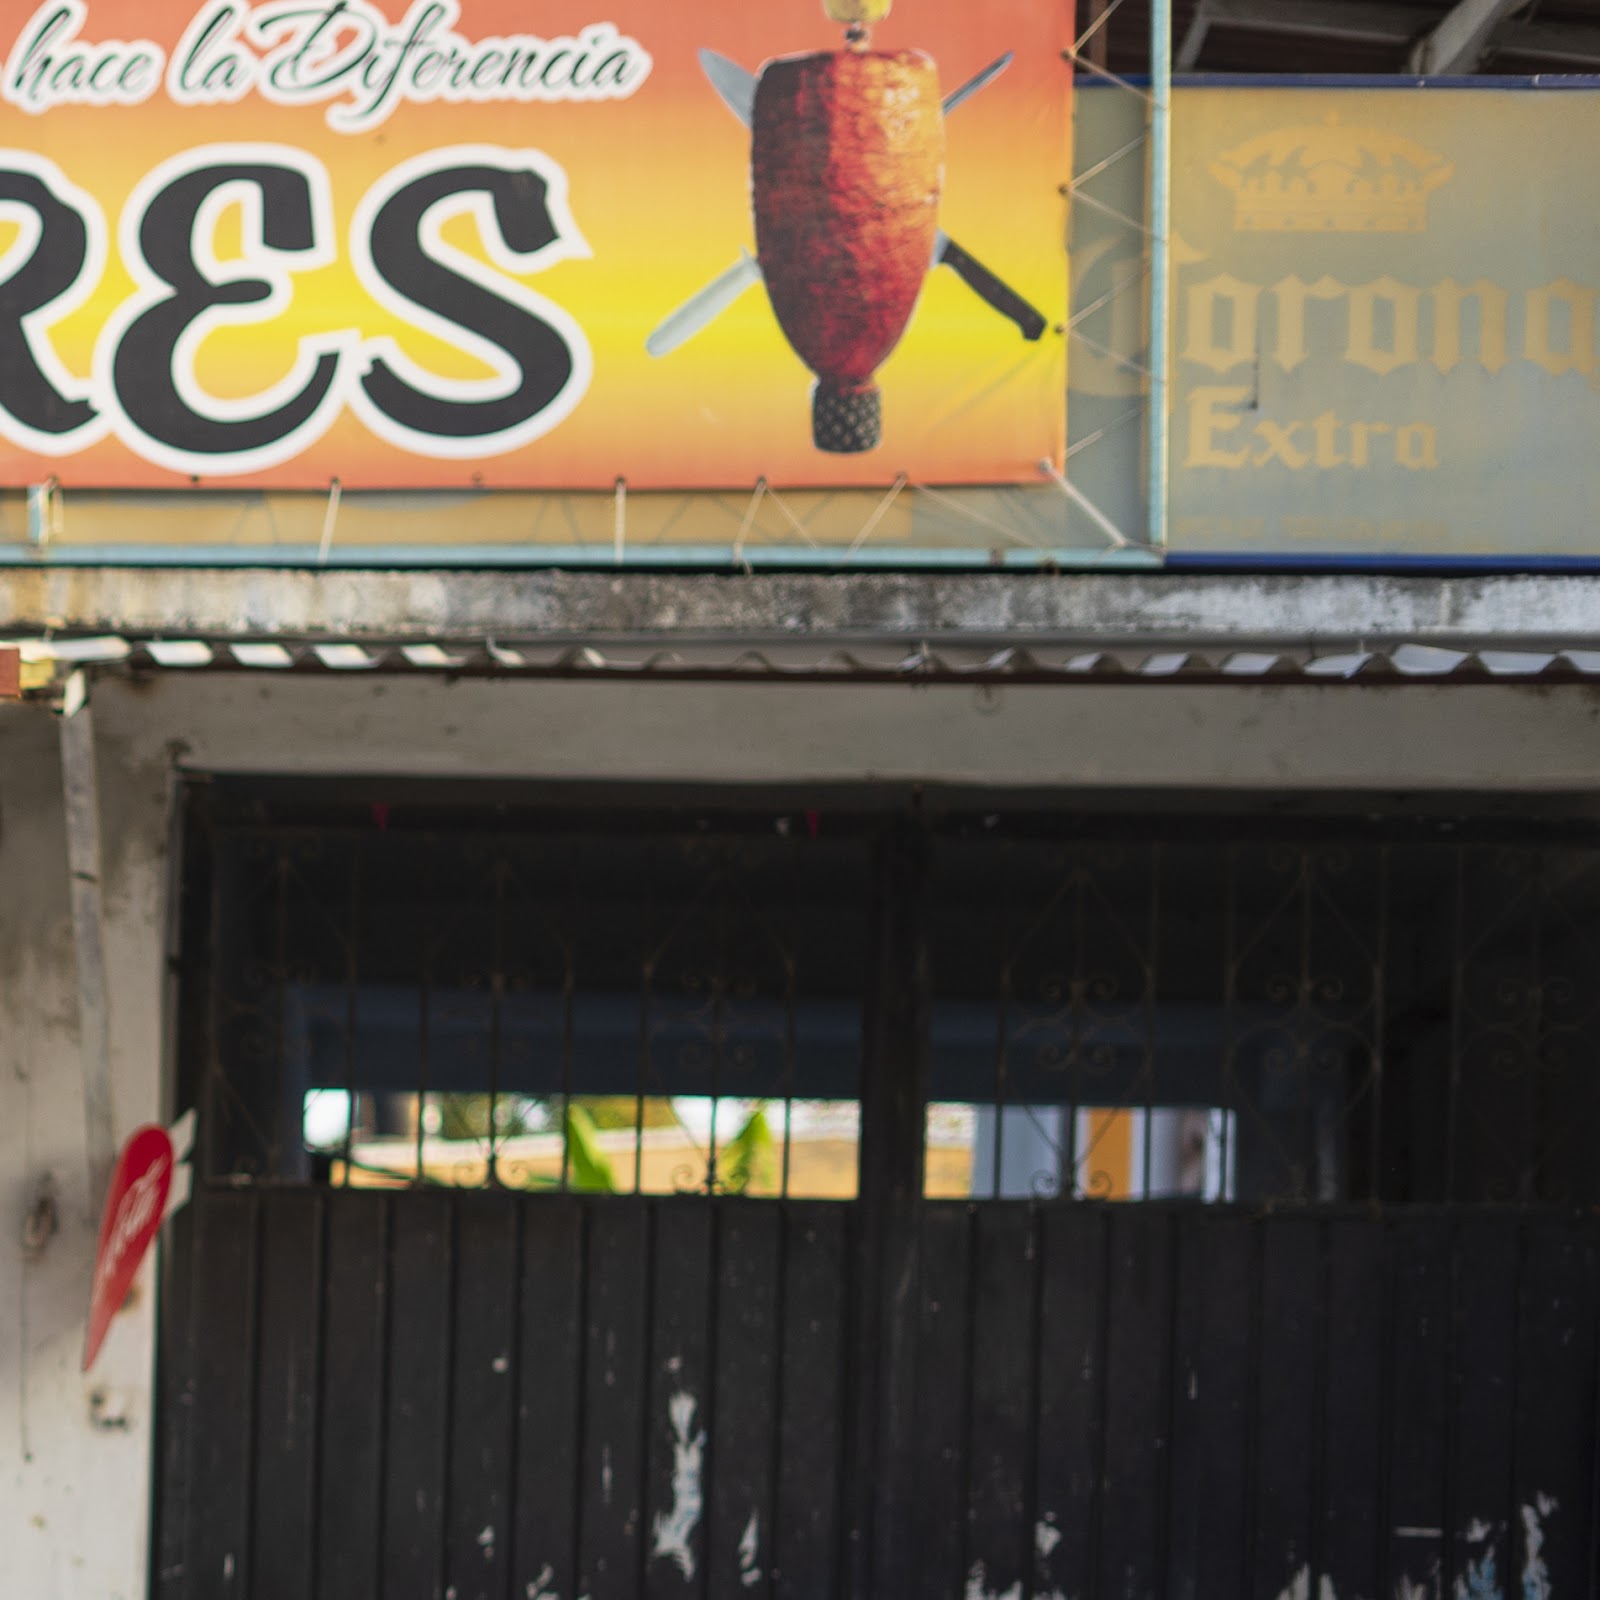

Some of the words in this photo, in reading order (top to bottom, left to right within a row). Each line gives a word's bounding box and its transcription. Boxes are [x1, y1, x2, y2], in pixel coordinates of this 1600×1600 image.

[12, 5, 154, 100] hace
[179, 5, 245, 94] la
[259, 0, 634, 119] Diferencia
[1183, 385, 1441, 470] Extra
